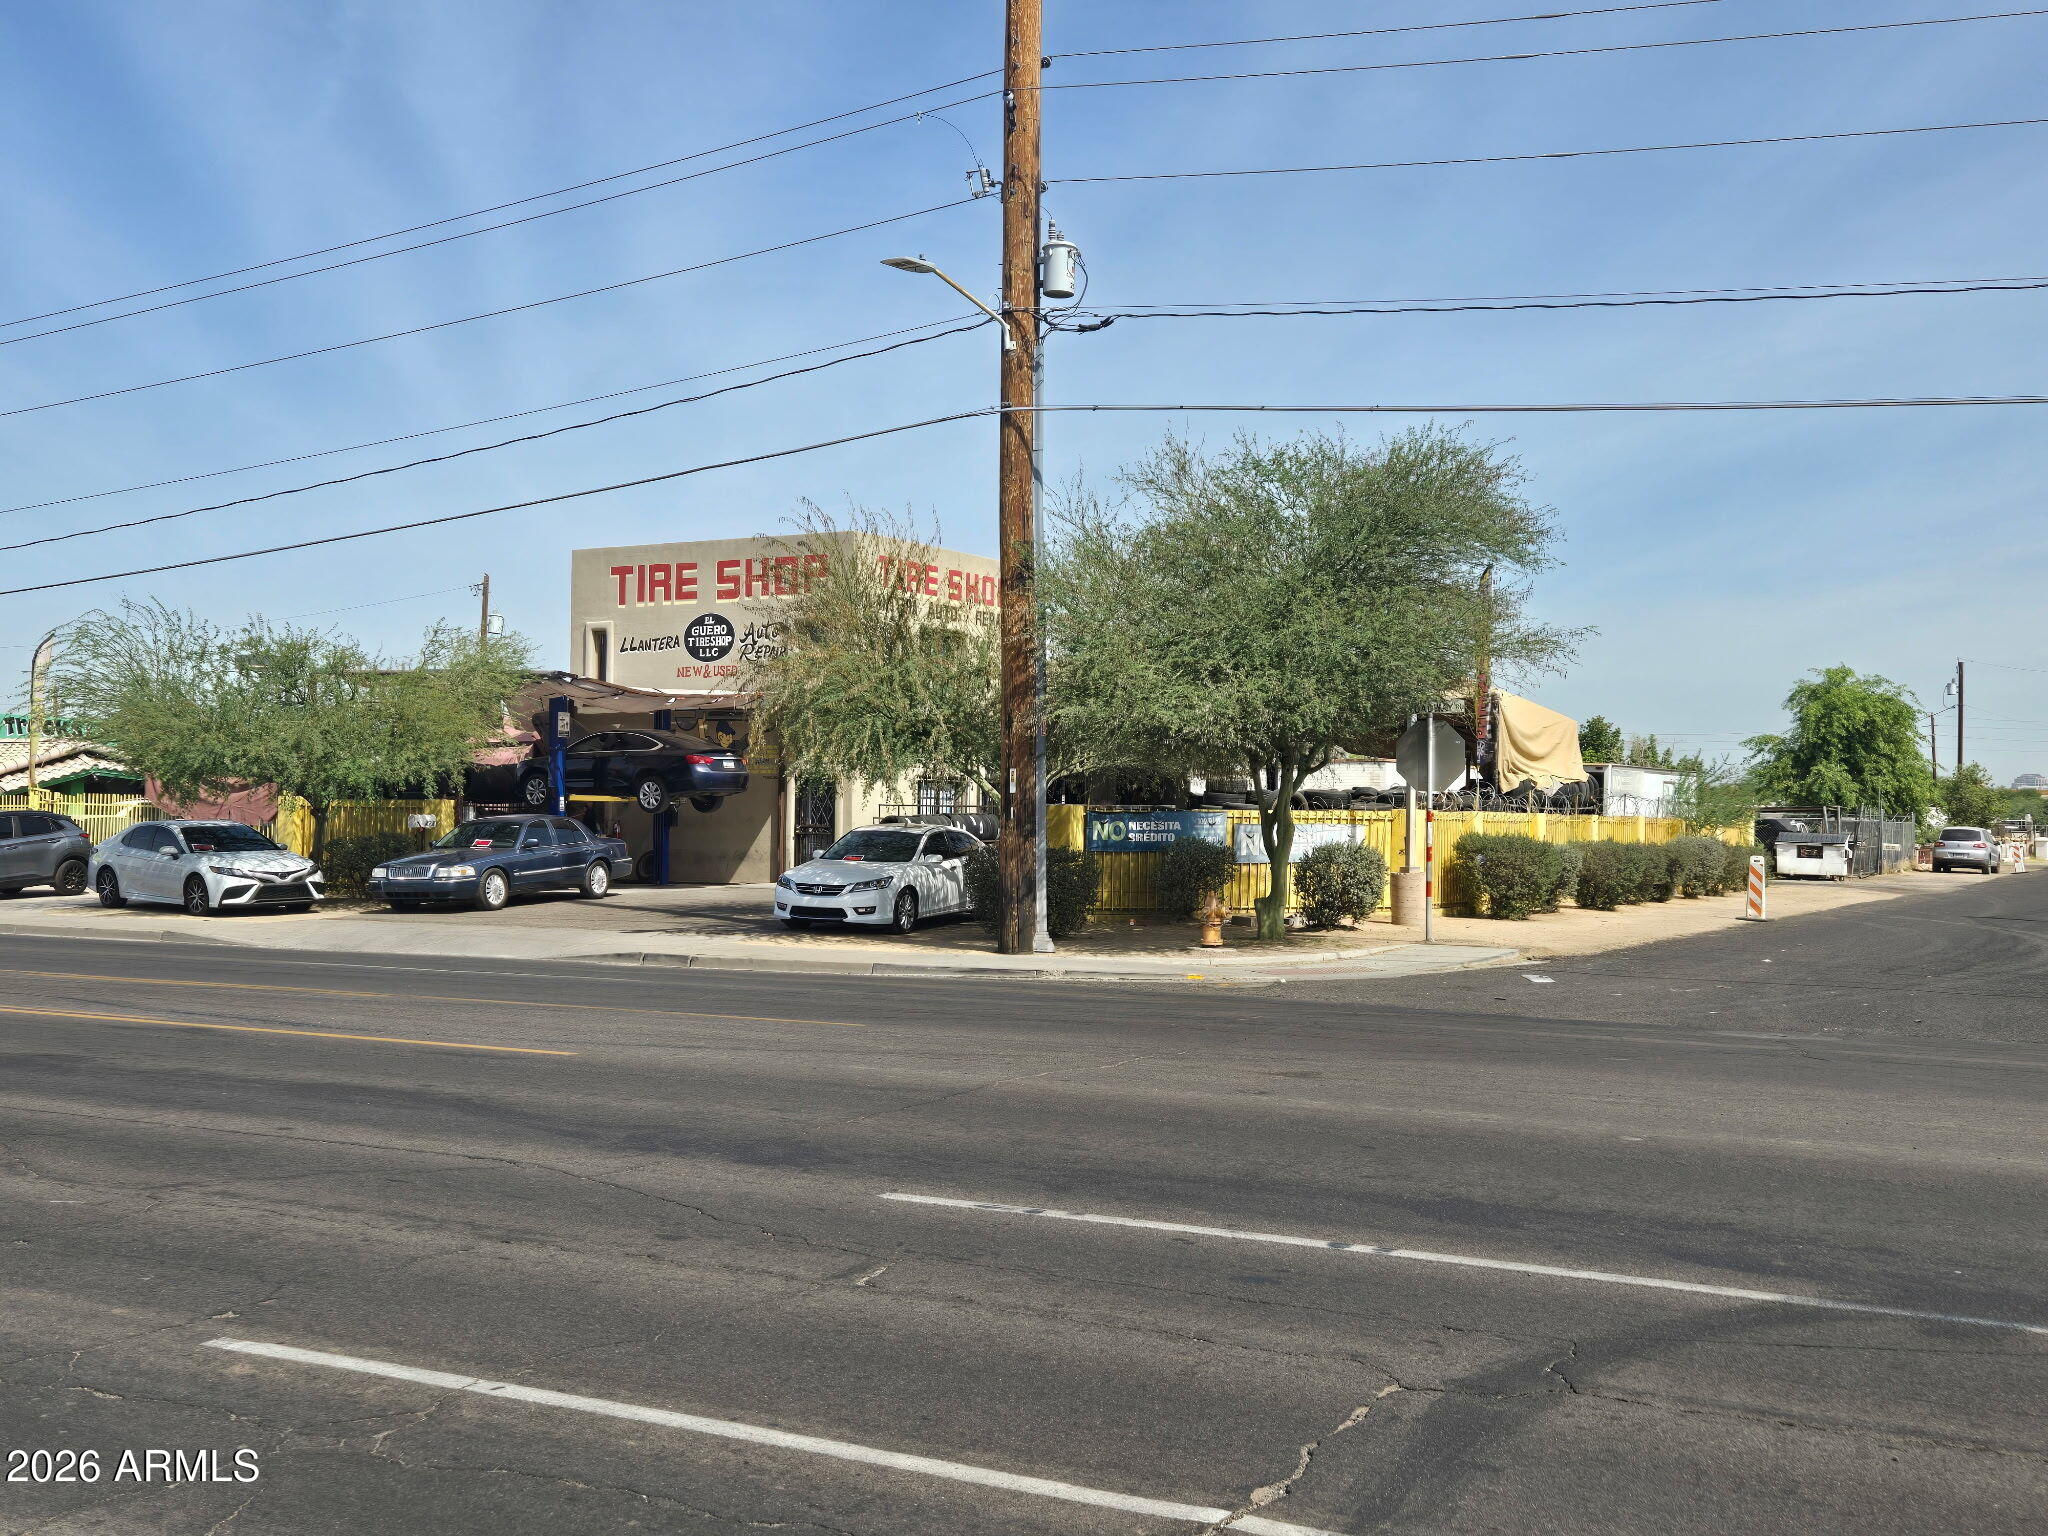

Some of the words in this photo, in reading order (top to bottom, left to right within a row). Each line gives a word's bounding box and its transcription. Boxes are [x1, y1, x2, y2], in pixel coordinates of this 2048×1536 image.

[610, 562, 698, 607] TIRE
[715, 554, 828, 603] SHOP
[948, 569, 1000, 607] SHO
[704, 616, 715, 625] EL
[691, 625, 727, 636] GUERO
[619, 635, 680, 654] LLANTERA
[699, 648, 719, 657] LLC
[1092, 820, 1127, 841] NO
[1128, 821, 1181, 831] NECESITA
